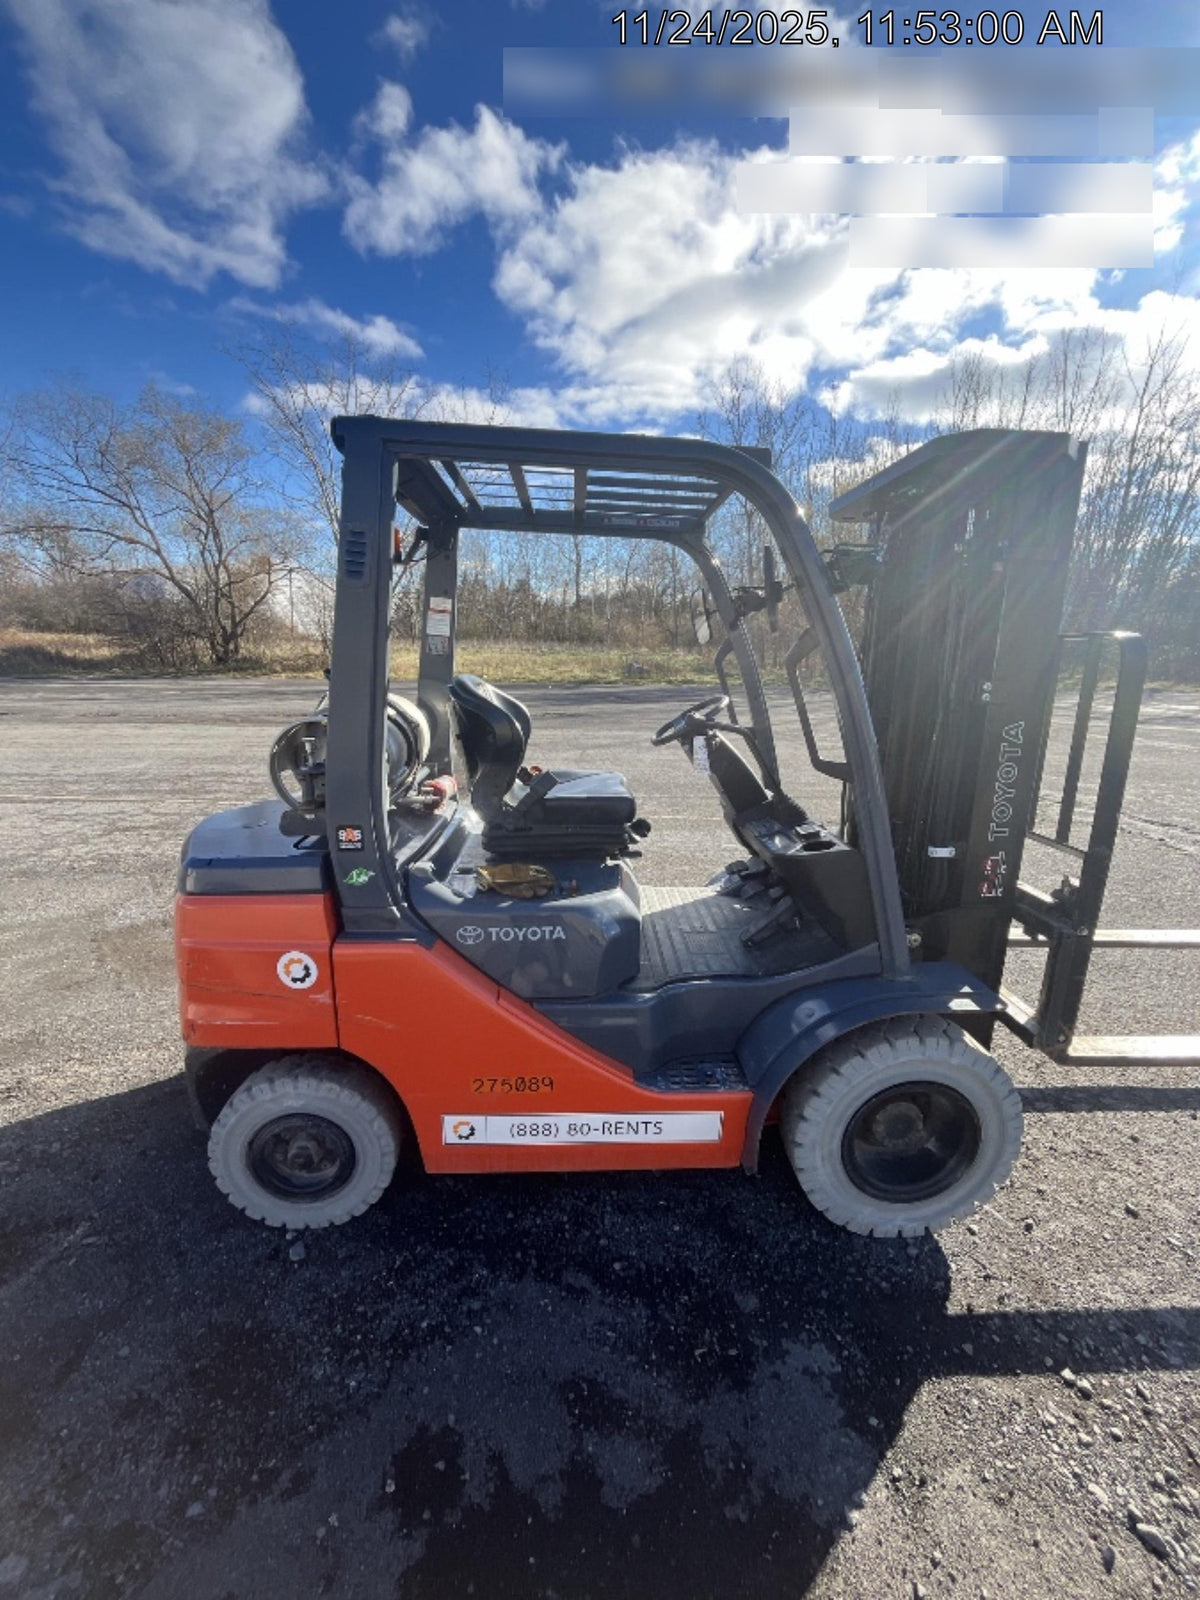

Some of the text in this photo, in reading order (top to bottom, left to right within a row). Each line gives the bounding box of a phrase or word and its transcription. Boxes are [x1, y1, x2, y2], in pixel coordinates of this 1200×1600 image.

[988, 721, 1025, 842] TOYOTA
[488, 925, 566, 941] TOYOTA
[472, 1076, 555, 1094] 275089
[509, 1121, 663, 1138] (888) 80-RENTS
